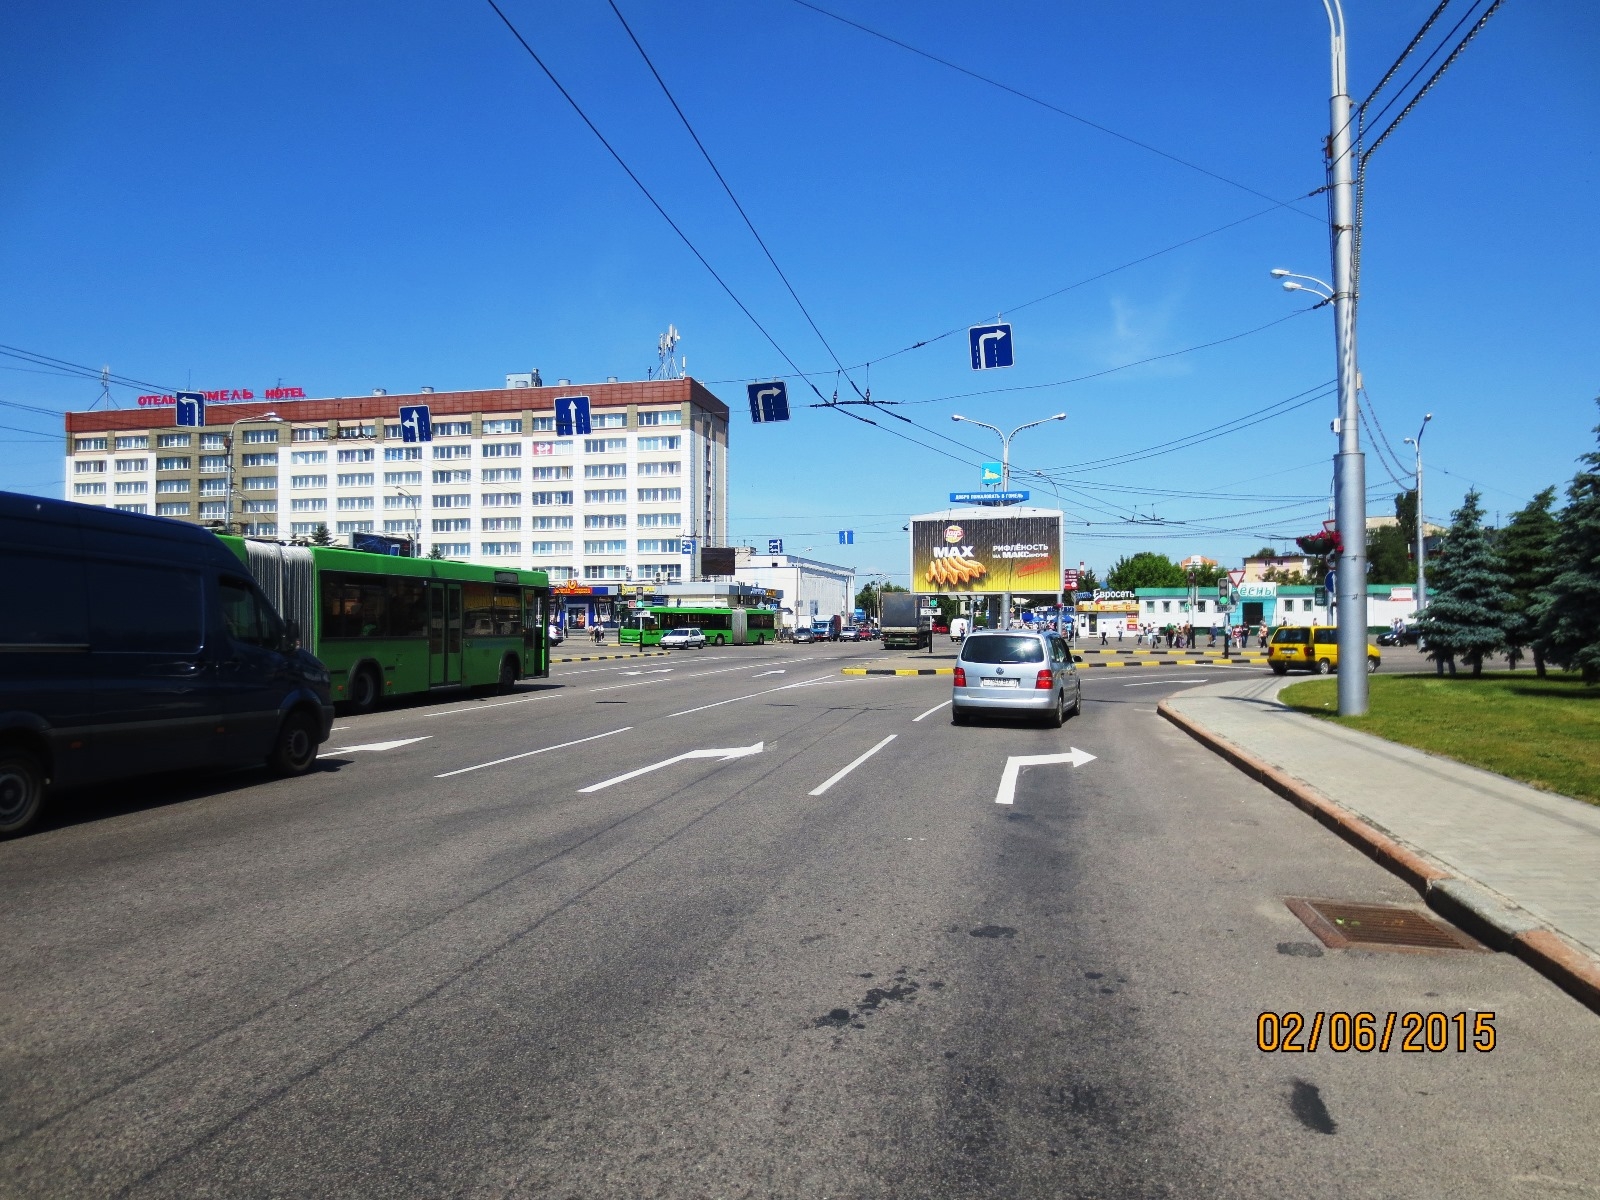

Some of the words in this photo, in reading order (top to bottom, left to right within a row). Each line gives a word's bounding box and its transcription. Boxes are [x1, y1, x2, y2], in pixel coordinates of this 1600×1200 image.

[137, 395, 176, 406] ОТЕЛЬ
[199, 388, 254, 402] МЕЛЬ
[265, 387, 306, 400] HOTEL
[933, 545, 975, 558] MAX
[992, 542, 1049, 552] РИФЛЁНОСТЬ
[1092, 588, 1135, 601] Евросеть
